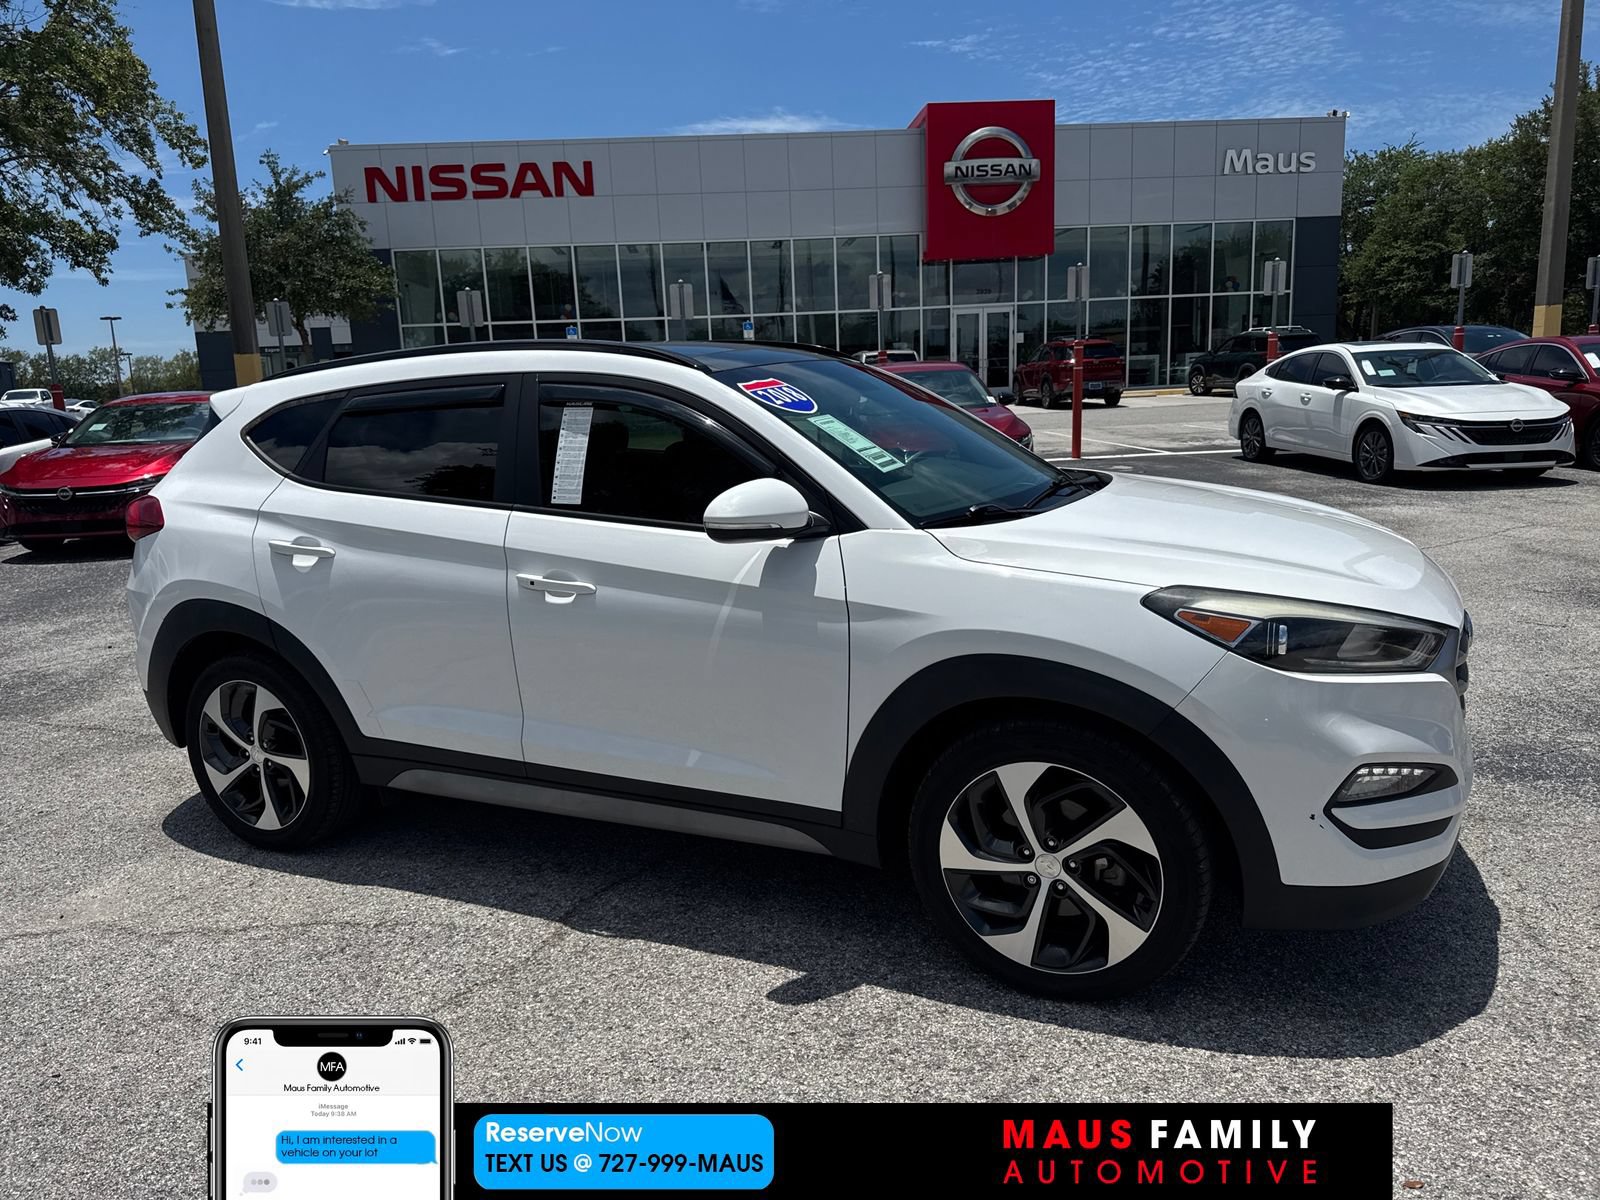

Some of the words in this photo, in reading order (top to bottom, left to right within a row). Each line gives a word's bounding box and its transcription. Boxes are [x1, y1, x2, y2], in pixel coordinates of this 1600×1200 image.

[954, 163, 1032, 178] NISSAN
[1223, 148, 1316, 175] Maus
[364, 160, 594, 203] NISSAN
[756, 386, 808, 405] 2018
